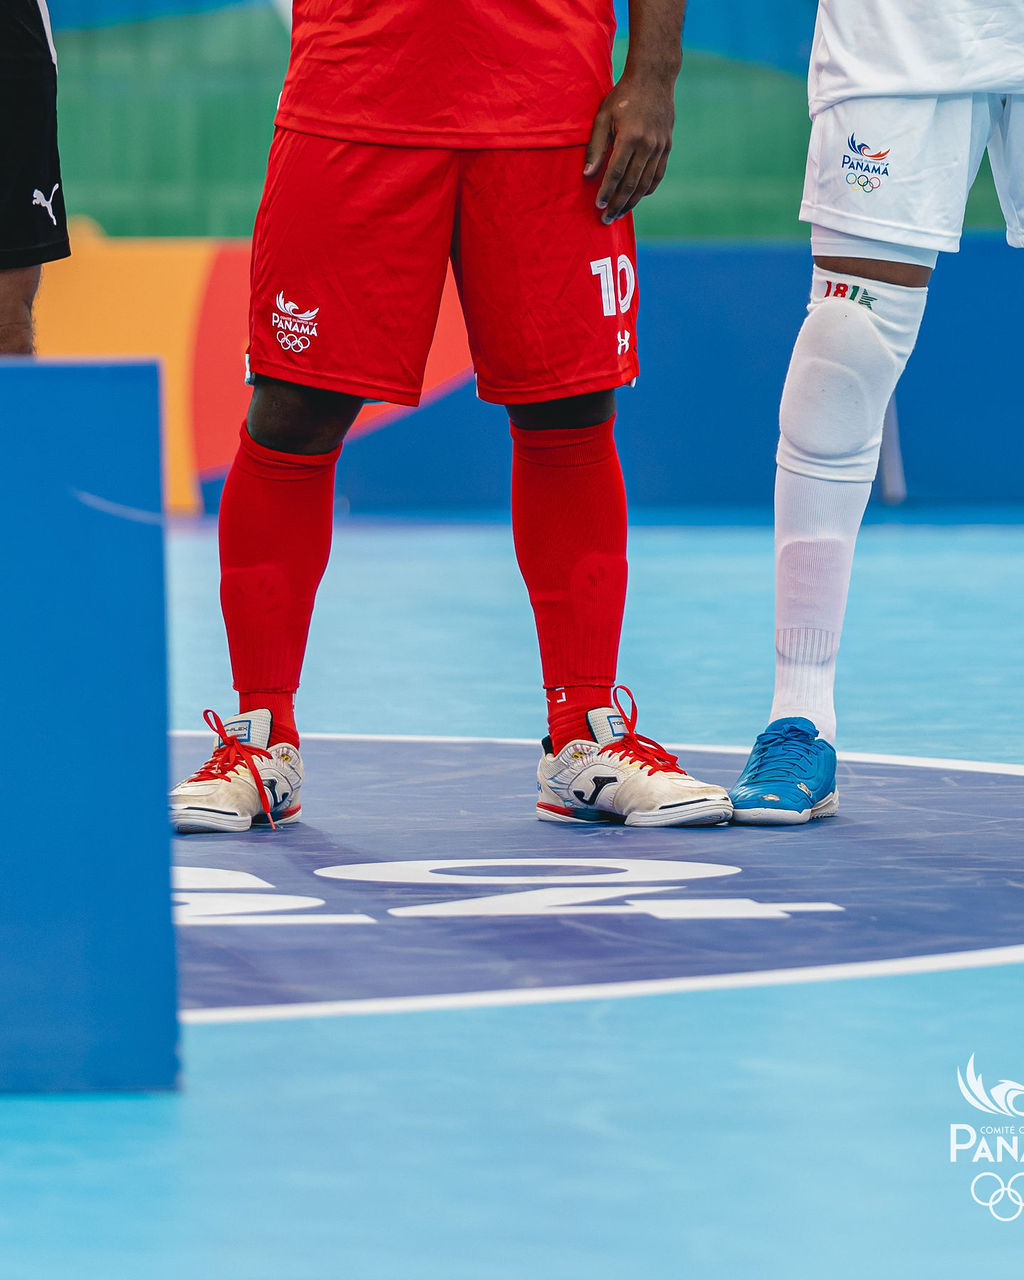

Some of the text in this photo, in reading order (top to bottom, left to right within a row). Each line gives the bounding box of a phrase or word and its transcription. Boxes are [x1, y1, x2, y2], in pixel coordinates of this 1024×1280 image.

[841, 154, 890, 176] PANAMÁ
[589, 253, 636, 317] 10
[823, 280, 860, 302] 181
[271, 312, 319, 337] PANAMÁ
